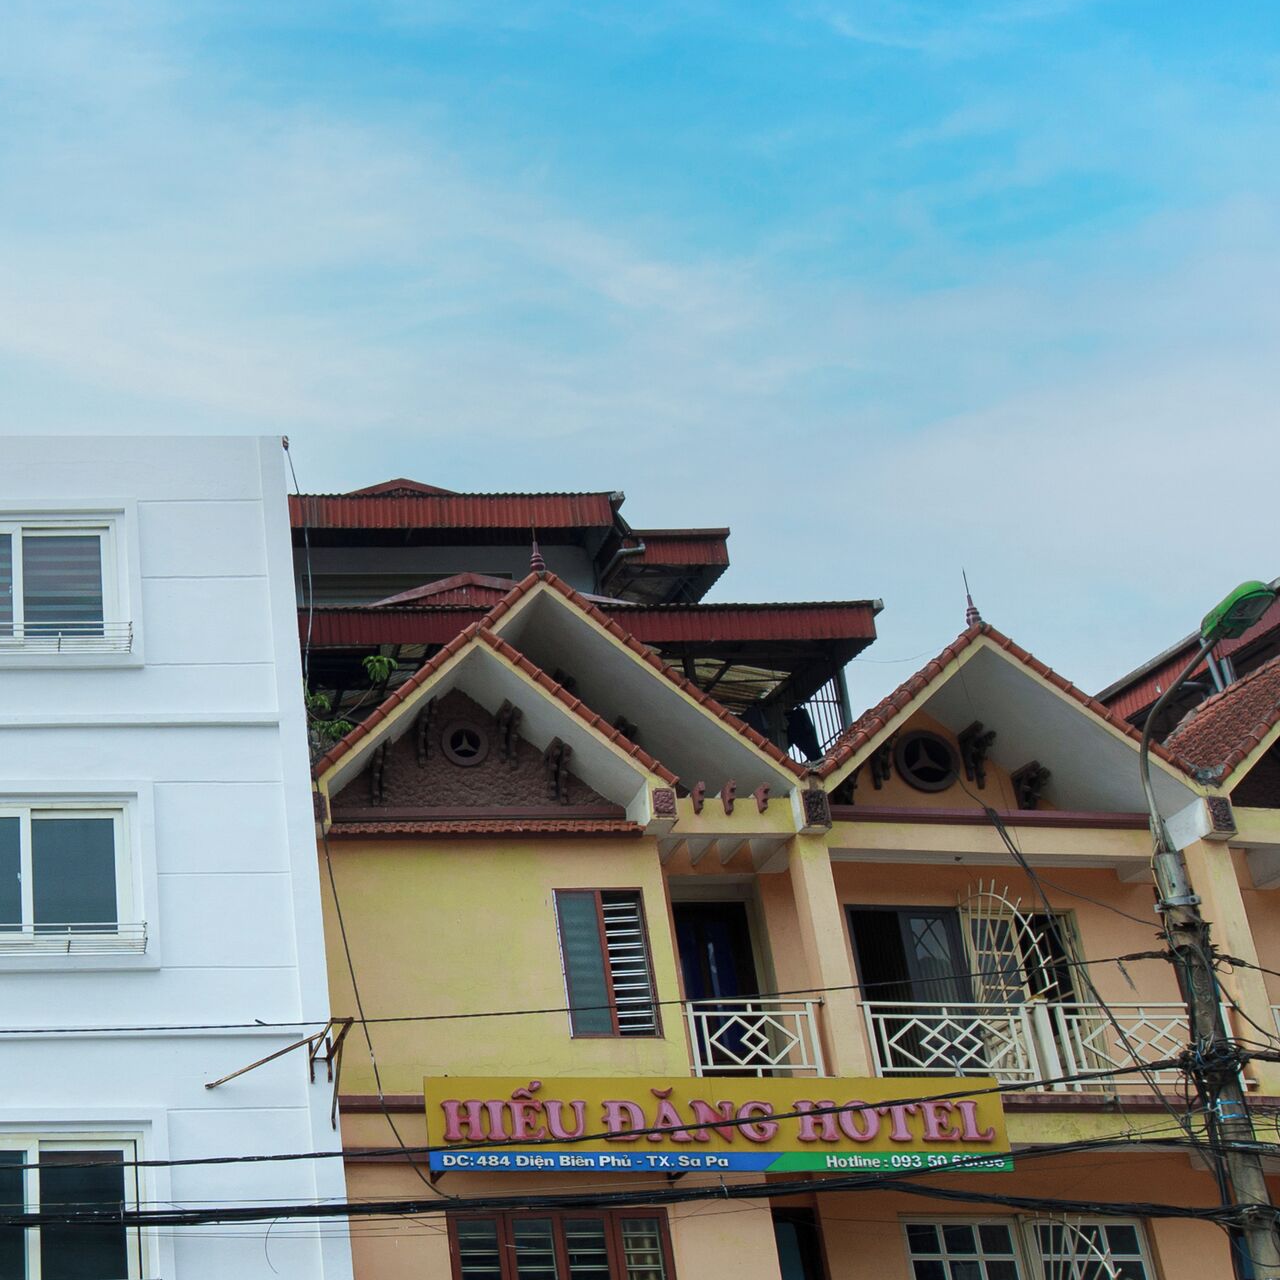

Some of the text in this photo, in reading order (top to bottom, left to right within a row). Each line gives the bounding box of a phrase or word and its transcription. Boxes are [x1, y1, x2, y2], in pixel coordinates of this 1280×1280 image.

[440, 1080, 996, 1143] HIẾU ĐĂNG HOTEL
[442, 1154, 474, 1166] ĐC:
[476, 1155, 511, 1166] 484
[516, 1155, 553, 1170] Điện
[559, 1155, 595, 1168] Biên
[599, 1154, 632, 1168] Phủ
[678, 1156, 702, 1167] Sa
[706, 1156, 729, 1167] Pa
[891, 1154, 922, 1168] 093
[927, 1155, 948, 1167] 50
